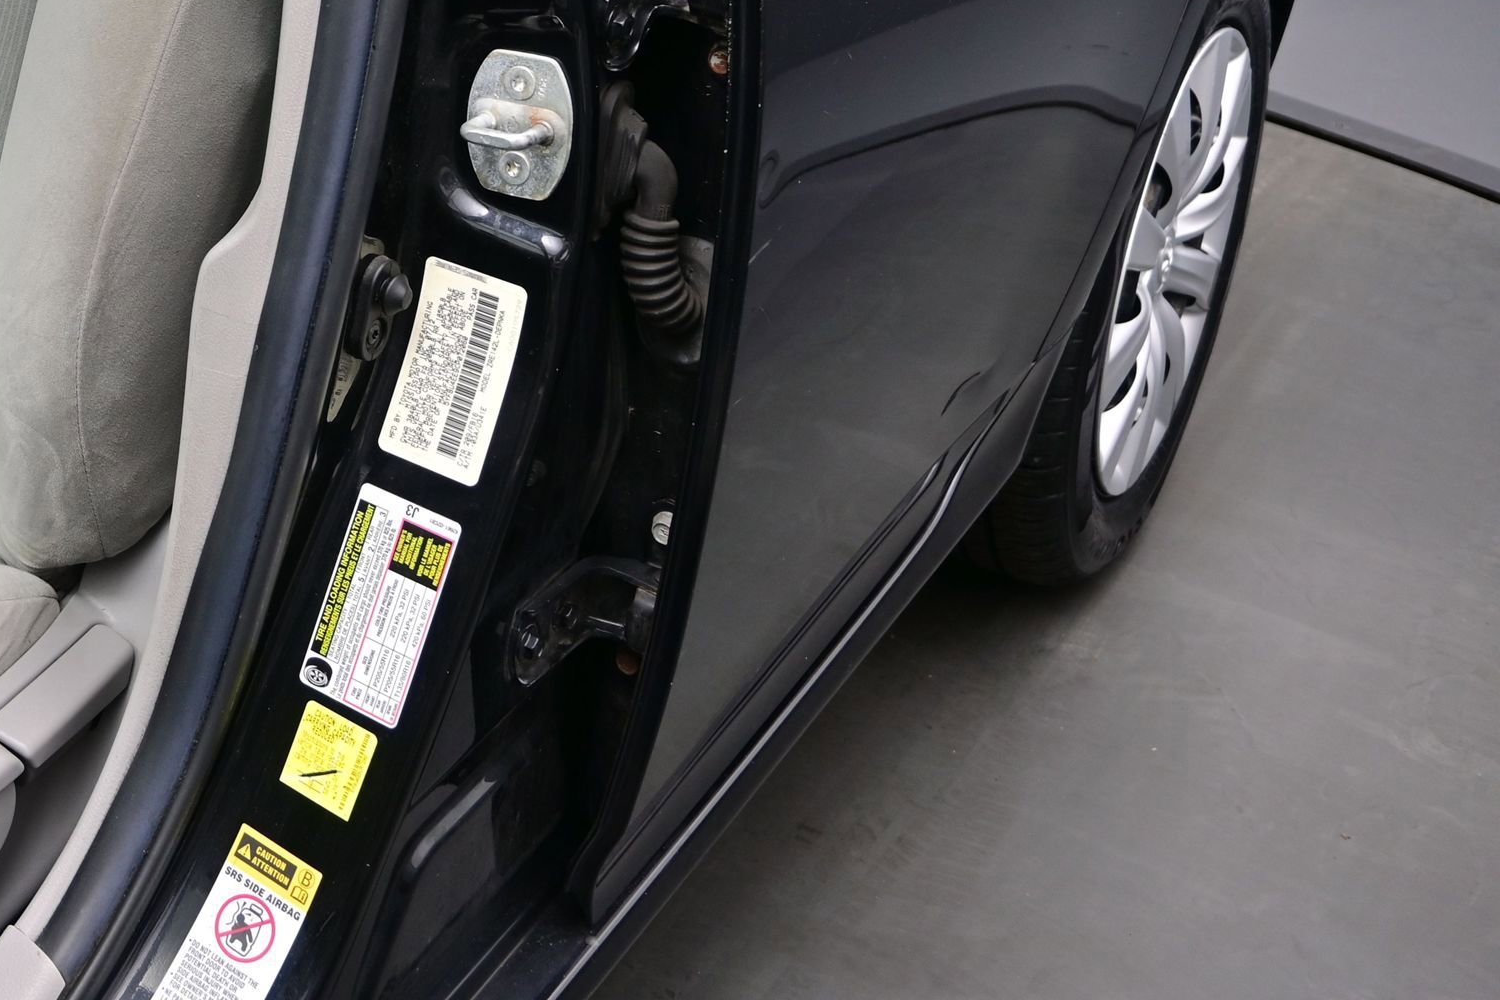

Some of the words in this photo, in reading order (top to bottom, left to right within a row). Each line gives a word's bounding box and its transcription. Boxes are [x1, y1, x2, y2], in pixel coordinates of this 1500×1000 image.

[465, 302, 475, 321] PASS
[470, 286, 478, 301] CAR
[398, 379, 411, 406] TOYOTA
[406, 355, 418, 378] MOTOR
[413, 299, 433, 354] MANUFACTURING
[479, 370, 491, 393] MODEL
[404, 502, 420, 520] J3
[355, 502, 375, 544] CHARGEMENT
[339, 509, 364, 567] INFORMATION
[352, 542, 362, 553] LE
[357, 575, 365, 583] 5
[378, 510, 387, 518] 3
[350, 551, 359, 561] ET
[344, 558, 357, 580] PNEUS
[327, 565, 346, 604] LOADING
[340, 578, 350, 592] LES
[400, 587, 410, 601] PSI
[336, 589, 346, 604] SUR
[397, 599, 406, 611] 32
[411, 592, 421, 606] PSI
[422, 597, 432, 611] PSI
[321, 602, 334, 623] AND
[408, 604, 417, 616] 32
[419, 610, 428, 621] 60
[315, 621, 328, 643] TIRE
[319, 602, 342, 656] RENSEIGNEMENTS
[388, 624, 398, 638] 220
[399, 629, 409, 644] 220
[410, 634, 420, 649] 420
[371, 647, 390, 688] P205/55R16
[382, 652, 401, 693] P205/55R16
[255, 845, 287, 871] CAUTION
[251, 856, 290, 886] ATTENTION
[224, 866, 244, 883] SRS
[243, 878, 266, 898] SIDE
[265, 894, 301, 921] AIRBAG
[184, 953, 211, 976] POTENTIAL
[211, 969, 230, 986] DEATH
[229, 982, 238, 994] OR
[187, 946, 206, 962] FRONT
[205, 957, 220, 973] DOOR
[220, 967, 230, 978] TO
[229, 974, 246, 990] AVOID
[191, 939, 200, 949] DO
[199, 944, 212, 956] NOT
[211, 951, 225, 967] LEAN
[225, 962, 248, 980] AGAINST
[247, 976, 260, 989] THE
[169, 979, 181, 991] FOR
[172, 973, 183, 985] SEE
[176, 966, 190, 980] SIDE
[189, 975, 211, 992] AIRBAG
[180, 959, 204, 979] SERIOUS
[203, 975, 223, 992] INJURY
